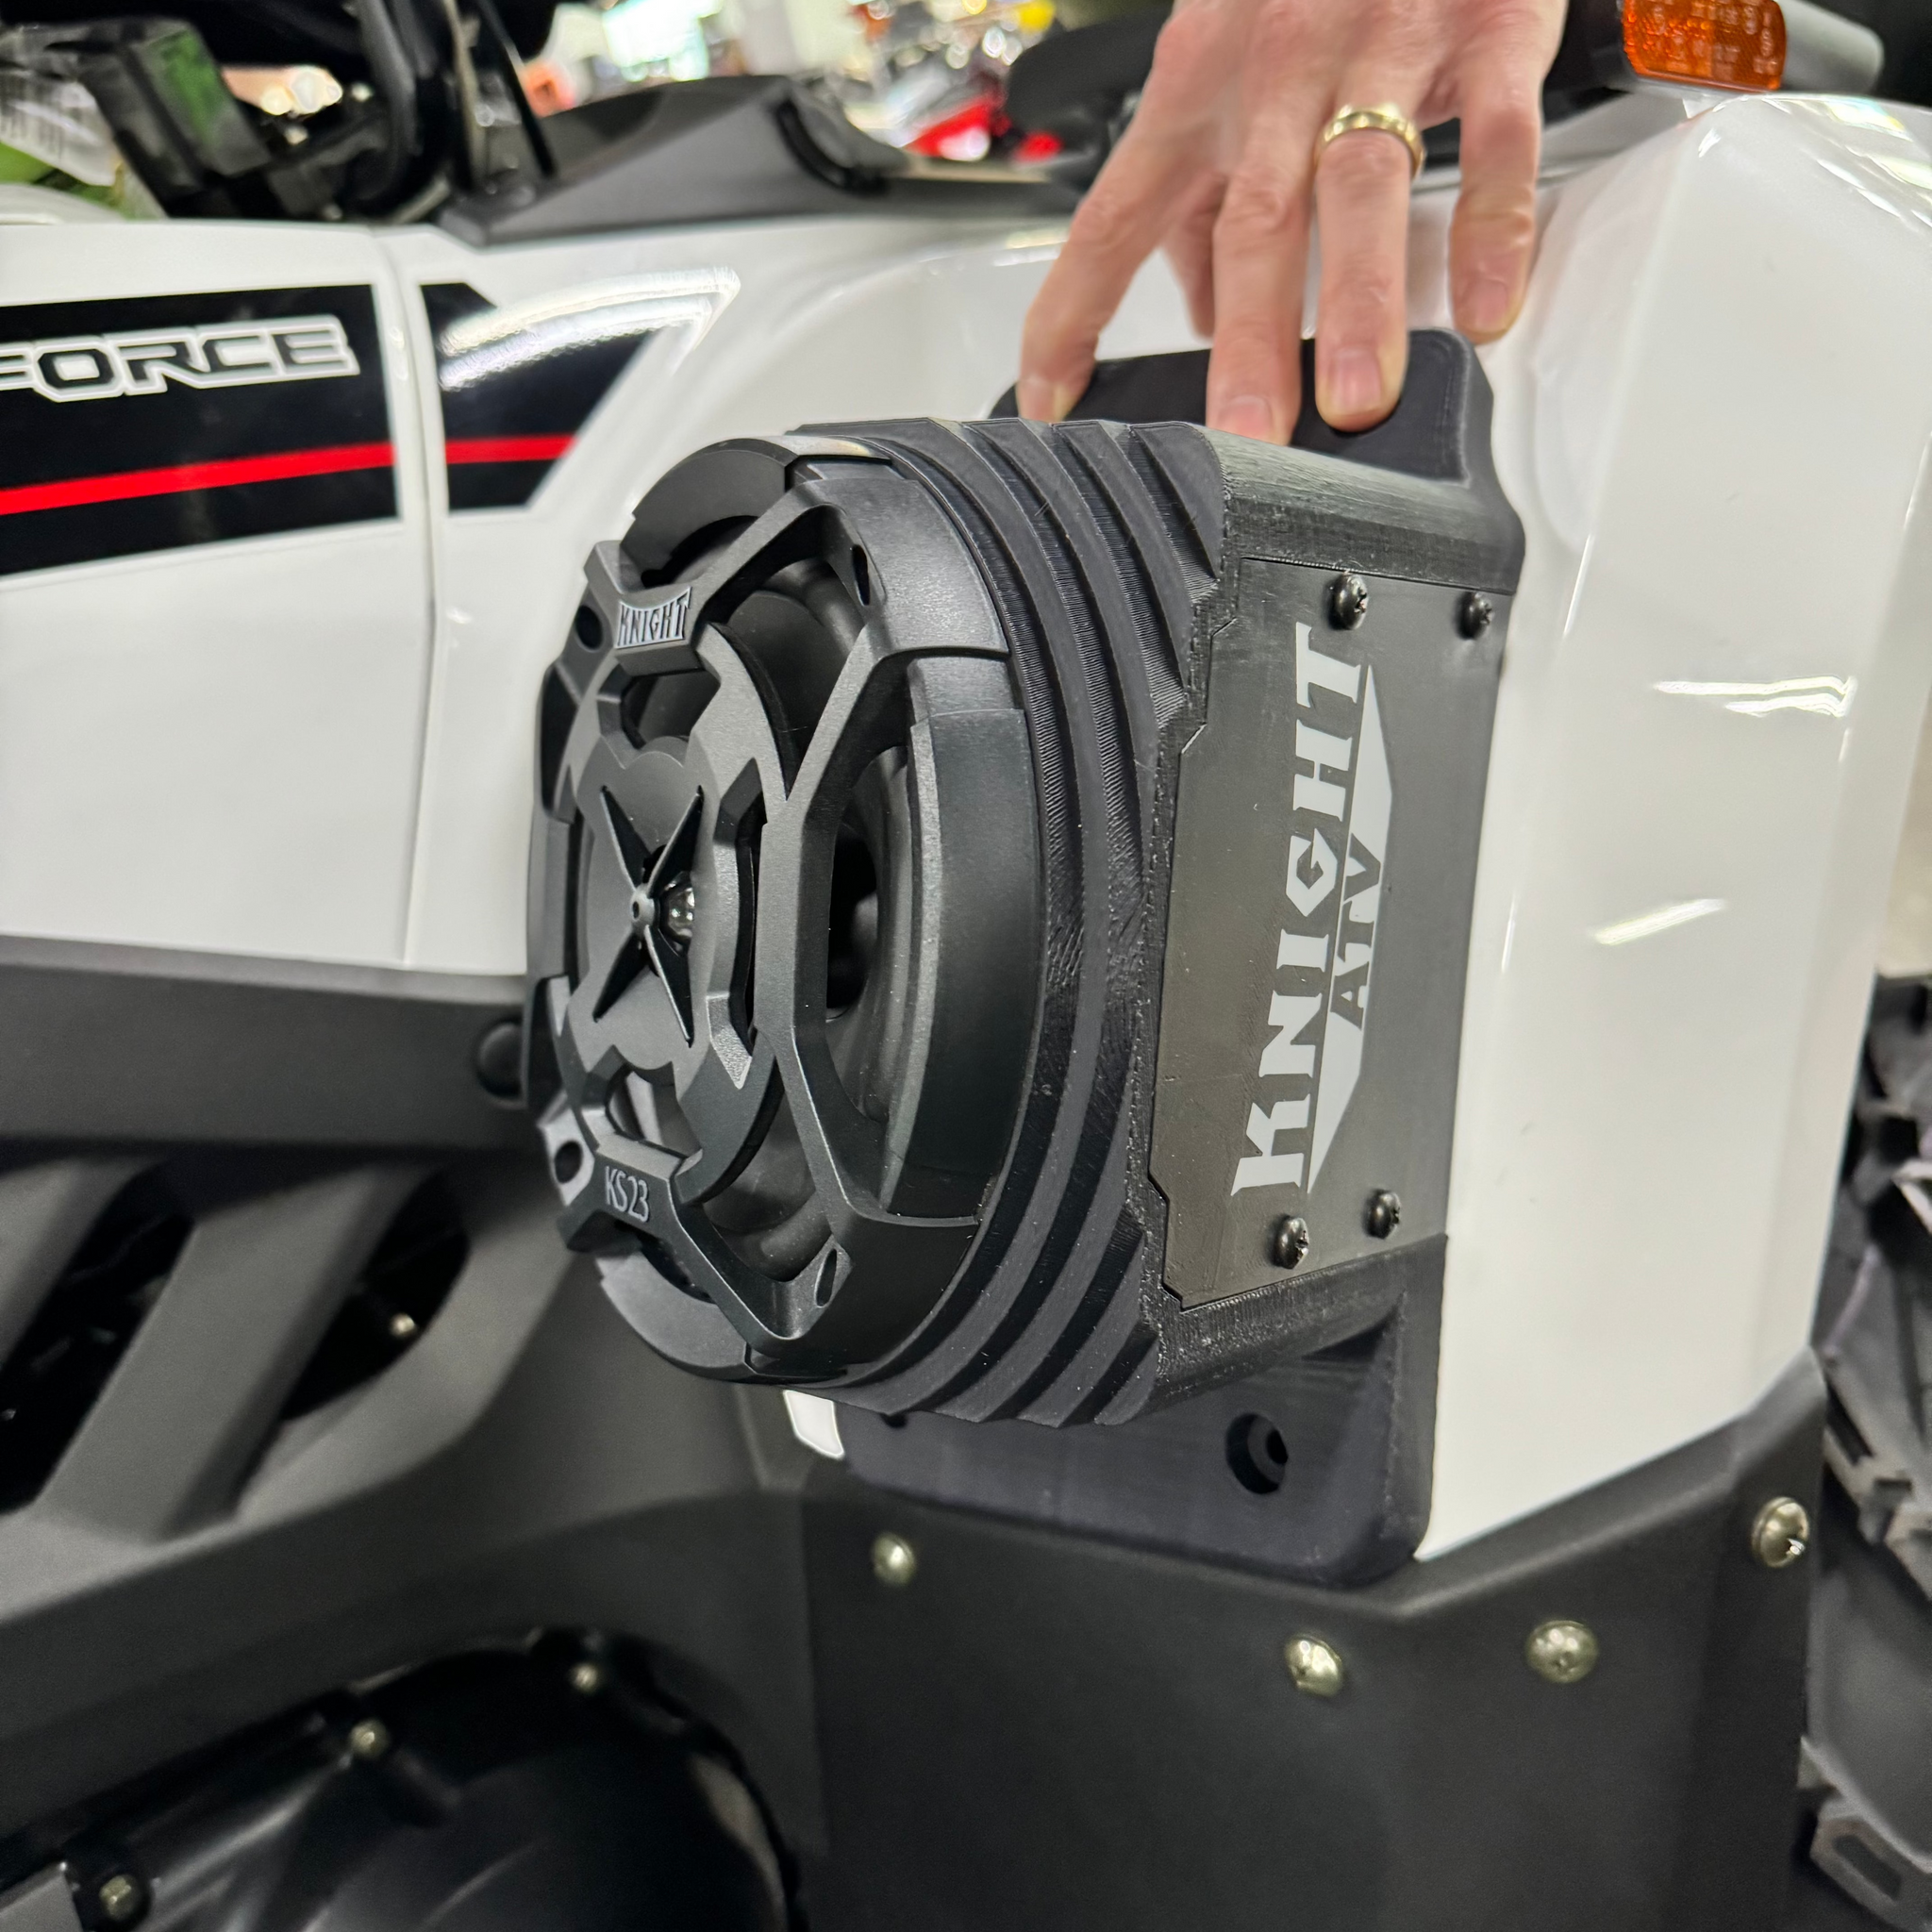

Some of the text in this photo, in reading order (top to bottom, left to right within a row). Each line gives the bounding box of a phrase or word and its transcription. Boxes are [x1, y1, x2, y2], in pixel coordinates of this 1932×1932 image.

[616, 587, 691, 648] KNIGHT
[1230, 622, 1361, 1195] KNIGHT
[1330, 833, 1381, 1029] ATV
[606, 1166, 649, 1223] KS23
